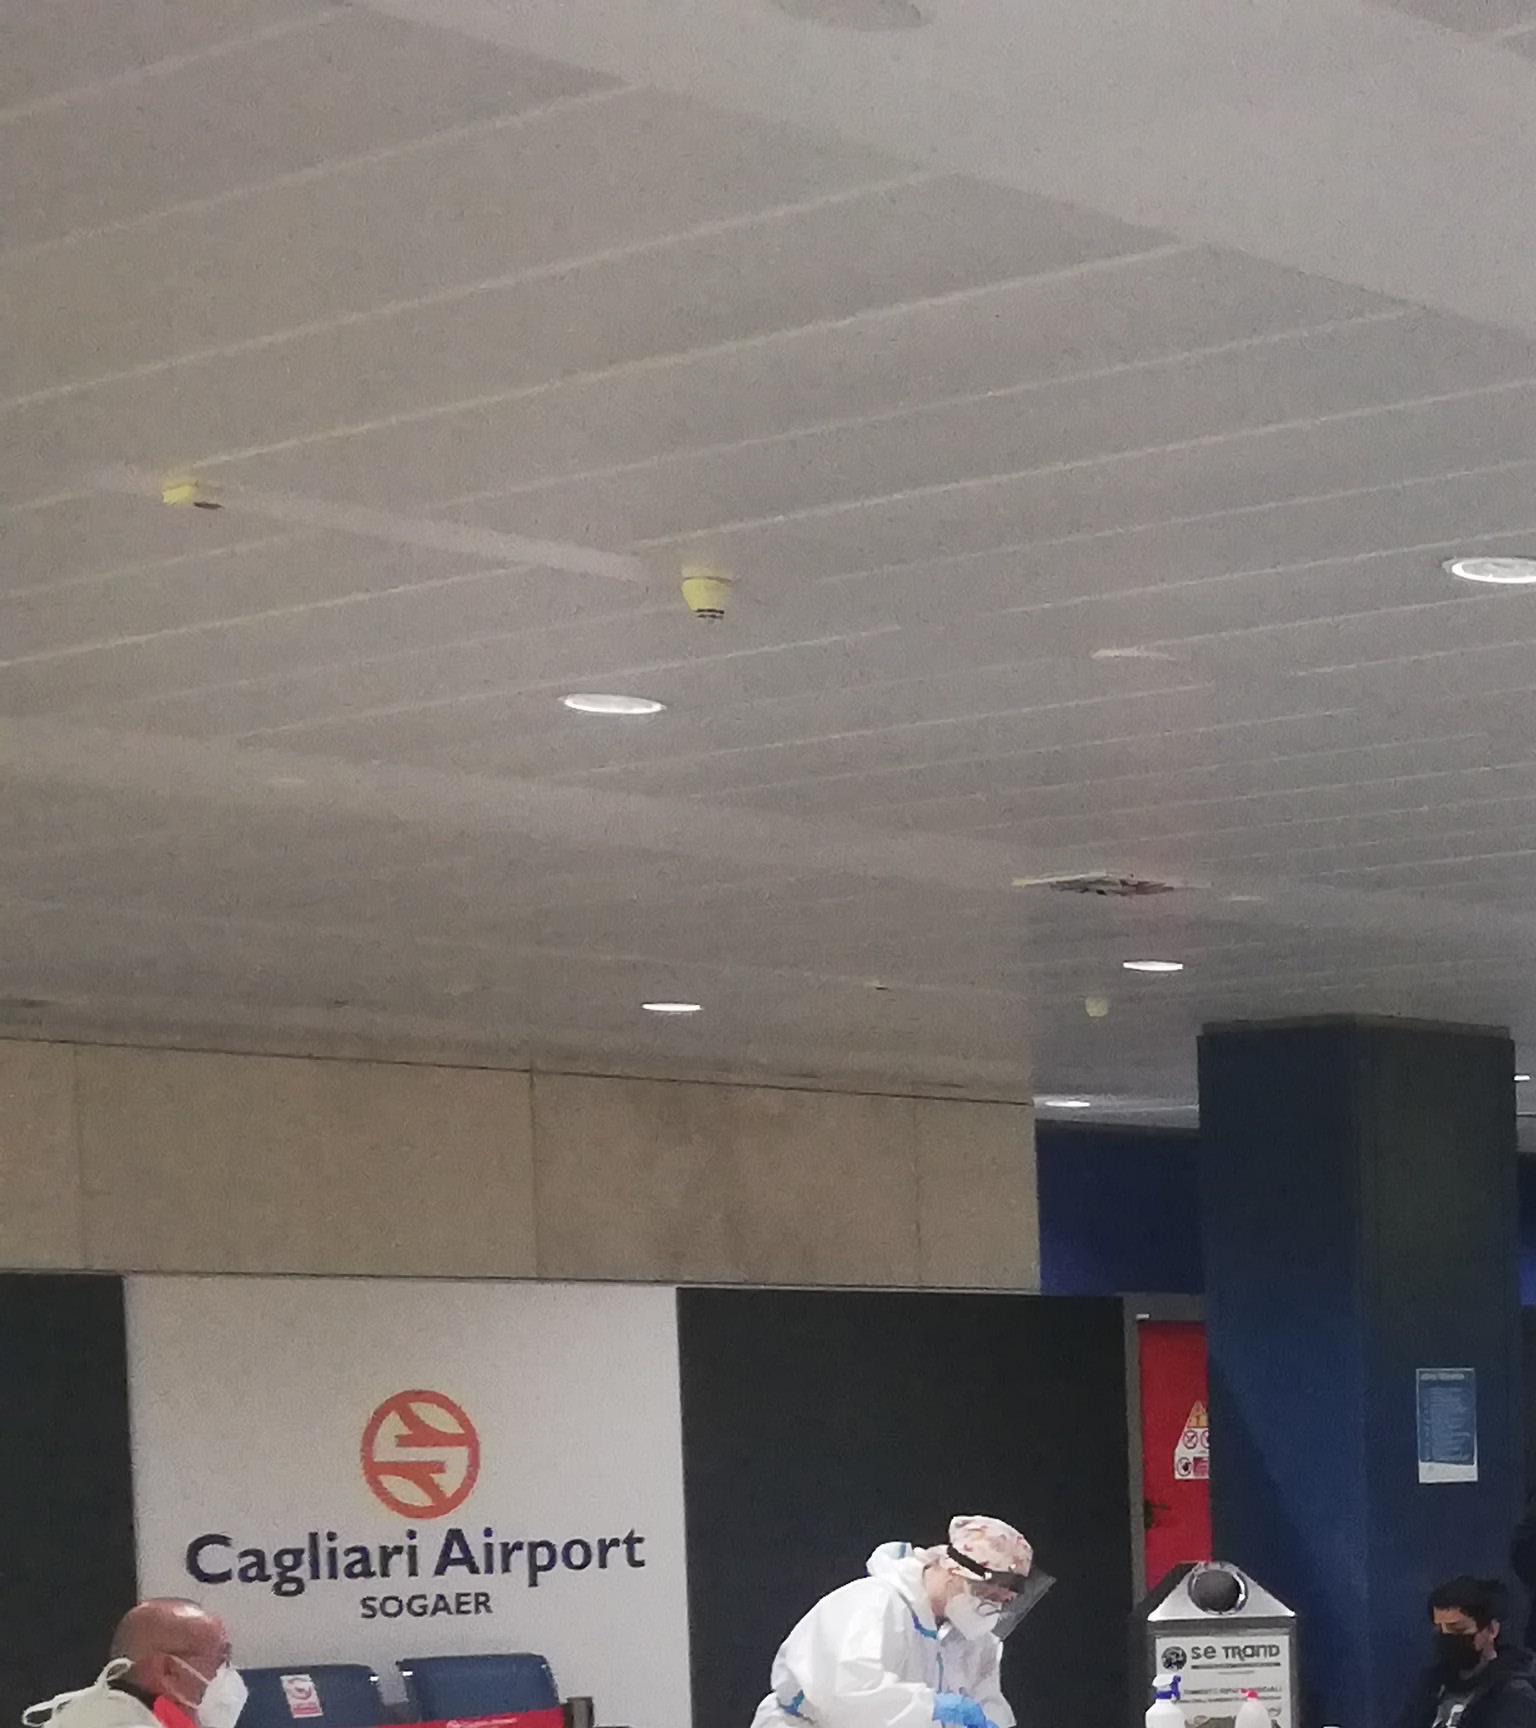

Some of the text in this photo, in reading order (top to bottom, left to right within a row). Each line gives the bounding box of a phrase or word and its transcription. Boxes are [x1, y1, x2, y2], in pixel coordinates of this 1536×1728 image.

[186, 1526, 646, 1596] Cagliari Airport
[360, 1592, 493, 1620] SOGAER
